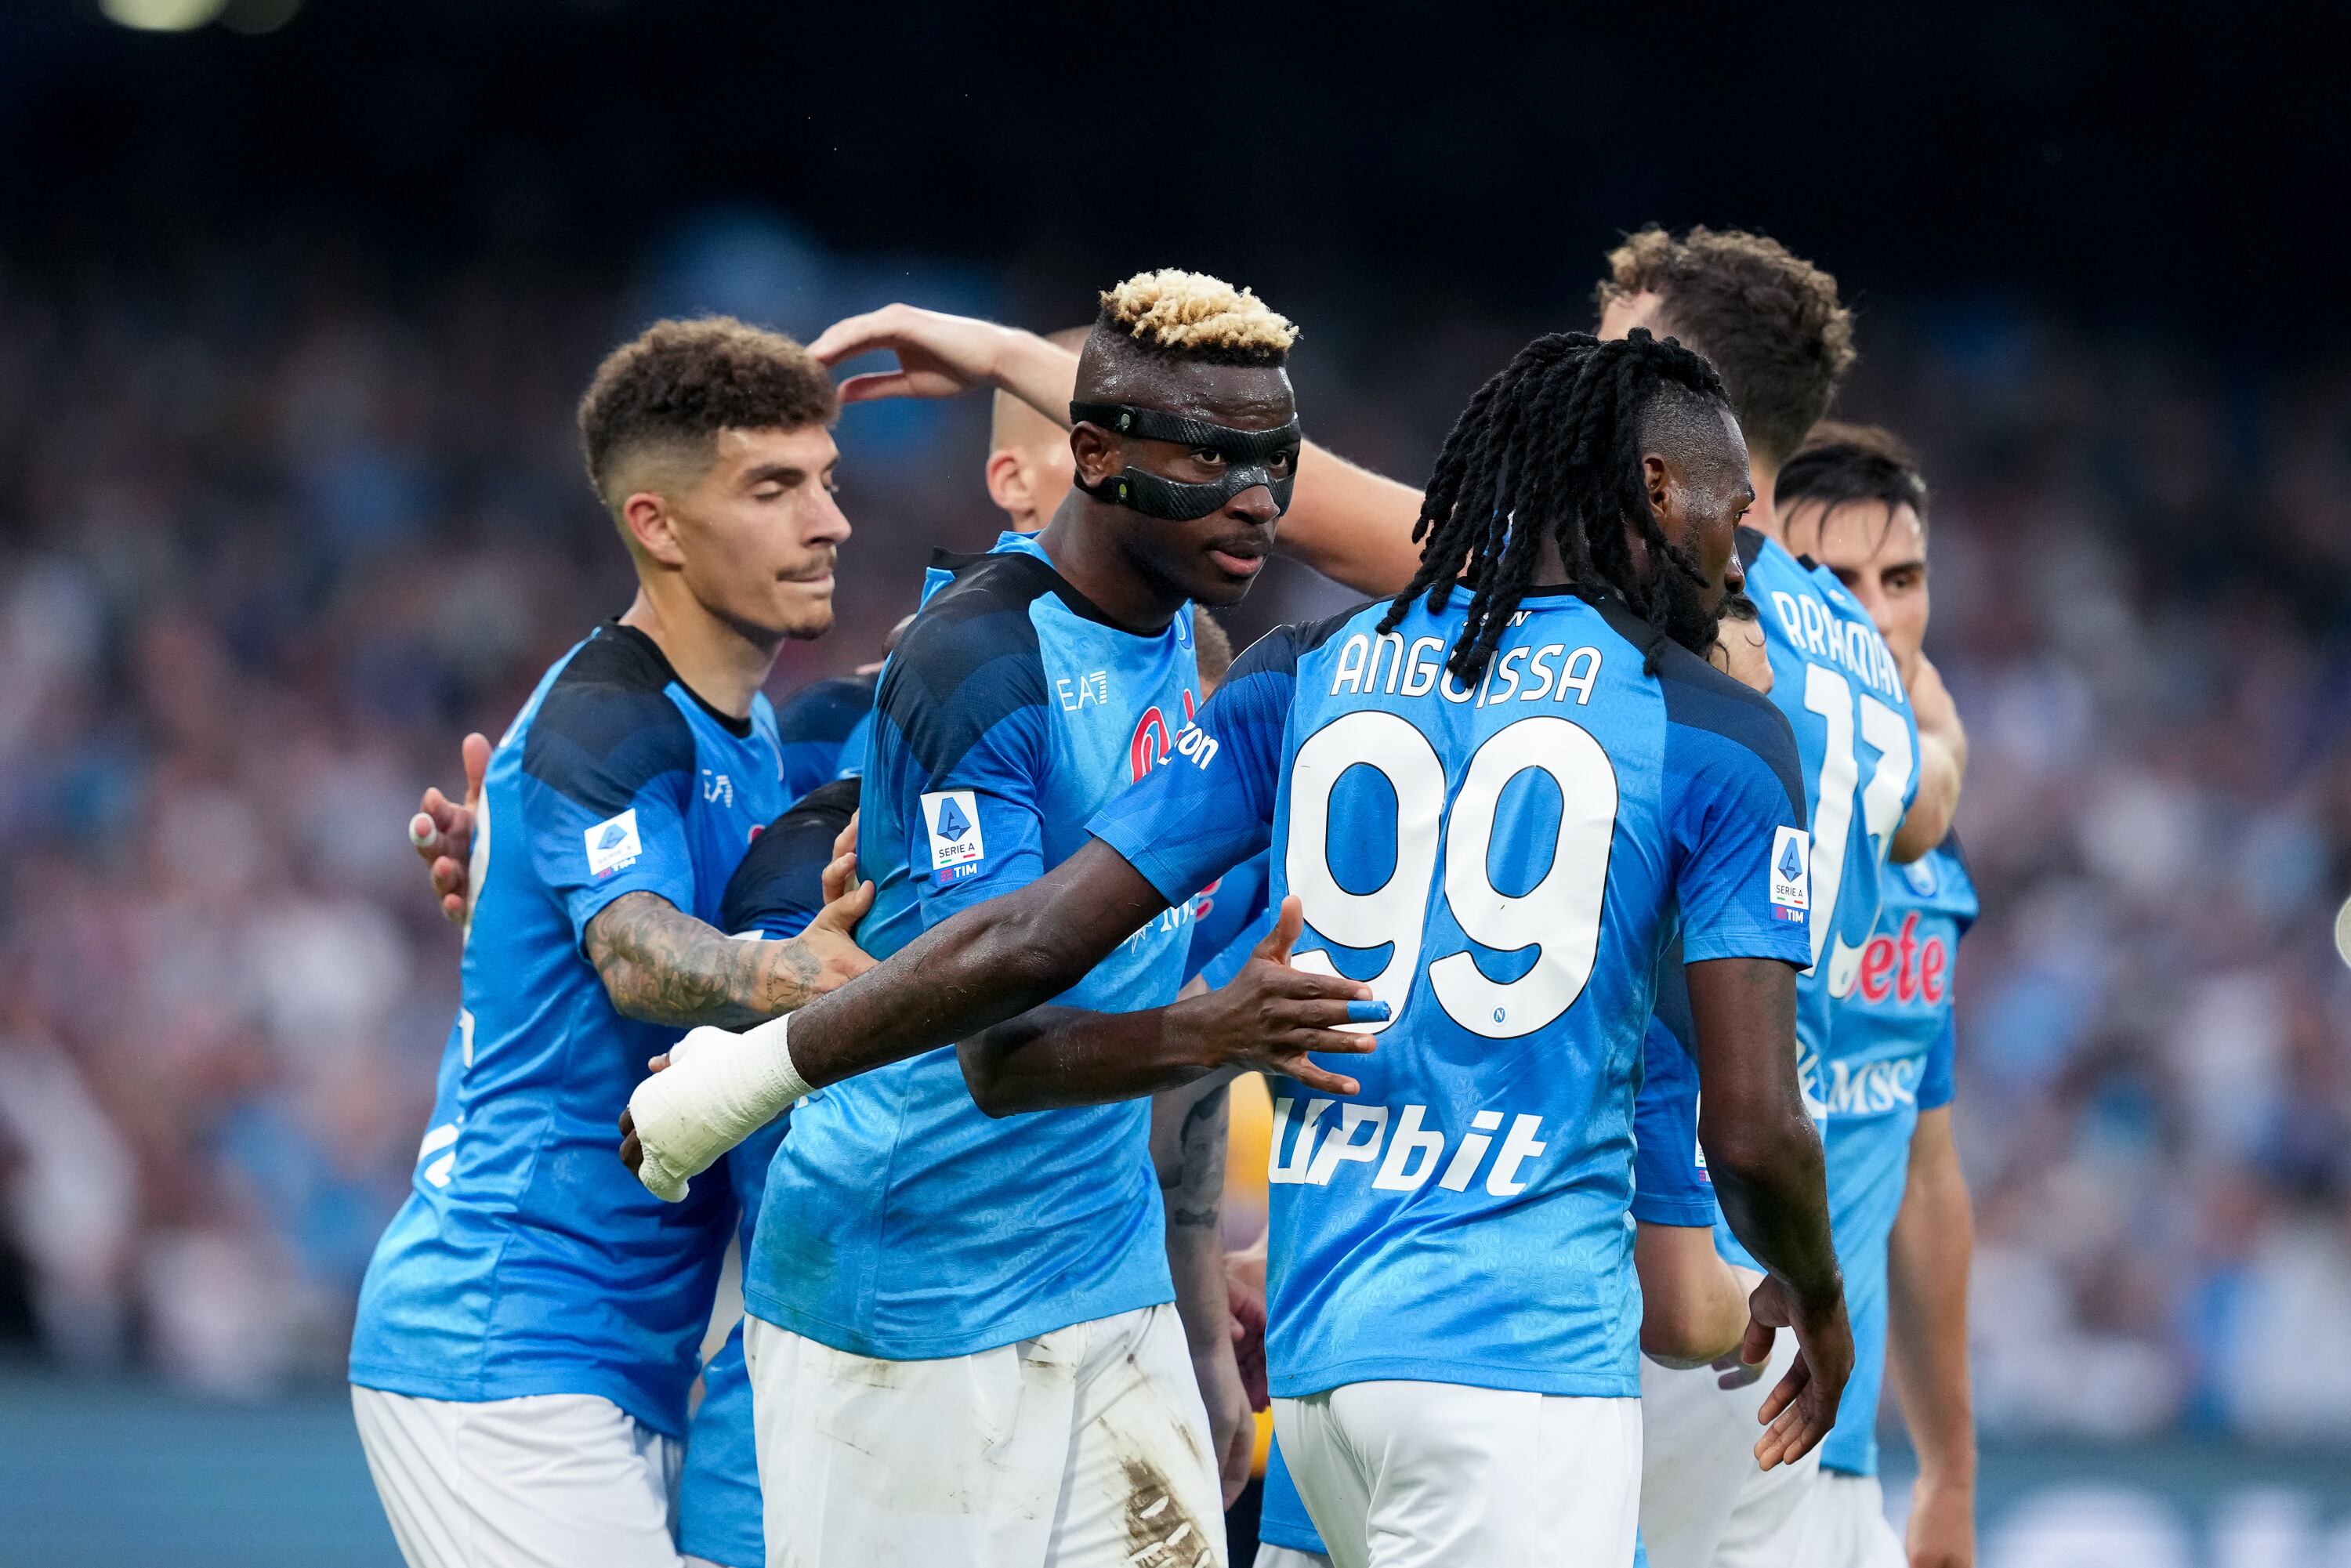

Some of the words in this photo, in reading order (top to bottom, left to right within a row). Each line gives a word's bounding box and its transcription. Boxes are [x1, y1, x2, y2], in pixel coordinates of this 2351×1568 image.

[1056, 670, 1107, 712] EA7
[1330, 632, 1603, 709] ANGUISSA
[939, 844, 965, 858] SERIE
[968, 842, 976, 852] A
[953, 863, 977, 878] TIM
[1285, 710, 1619, 1040] 99
[1776, 885, 1797, 896] SERIE
[1798, 889, 1803, 897] A
[1786, 908, 1804, 924] TIM
[1846, 911, 1945, 1006] ete
[1826, 1059, 1914, 1114] MSC
